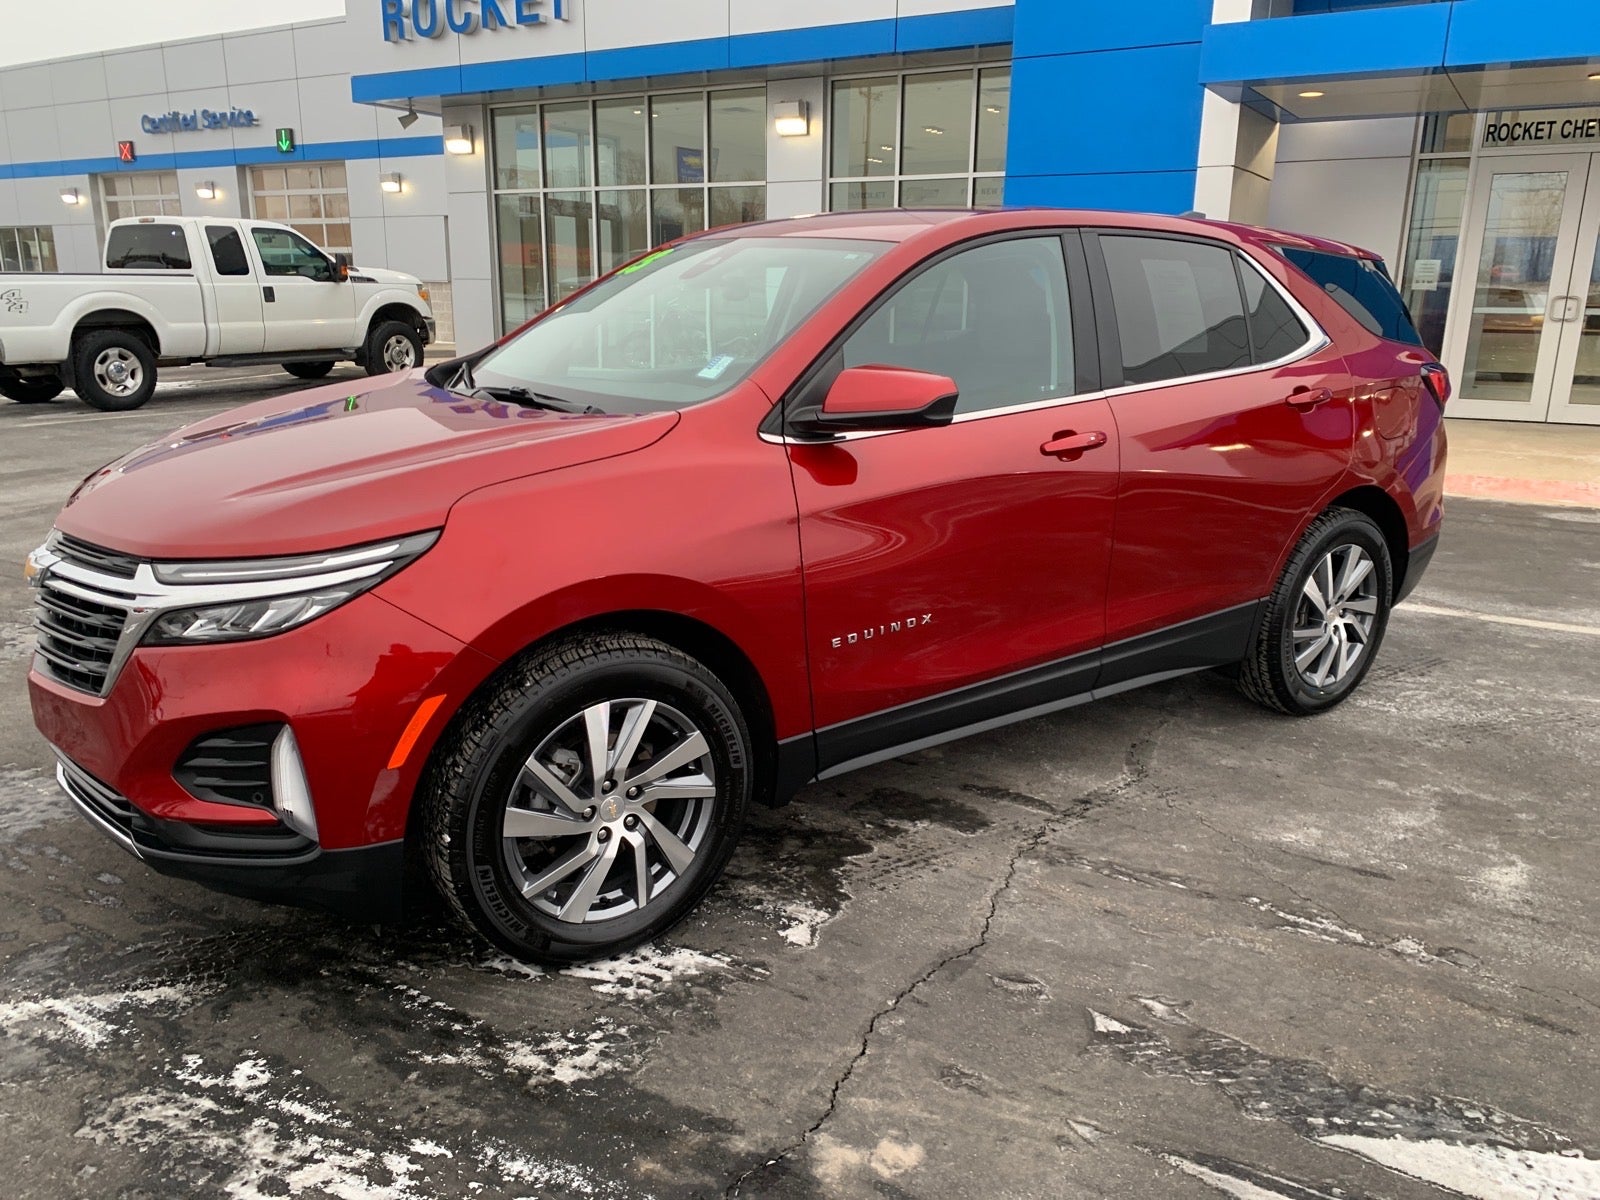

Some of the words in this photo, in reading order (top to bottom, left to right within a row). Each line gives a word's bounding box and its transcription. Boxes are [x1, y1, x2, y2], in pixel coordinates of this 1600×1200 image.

[141, 110, 198, 134] Certified
[201, 106, 257, 130] Service
[1485, 121, 1557, 142] ROCKET
[1561, 118, 1600, 139] CHE
[831, 613, 932, 648] EQUINOX
[708, 703, 741, 765] MICHELIN
[478, 869, 525, 934] MICHELIN
